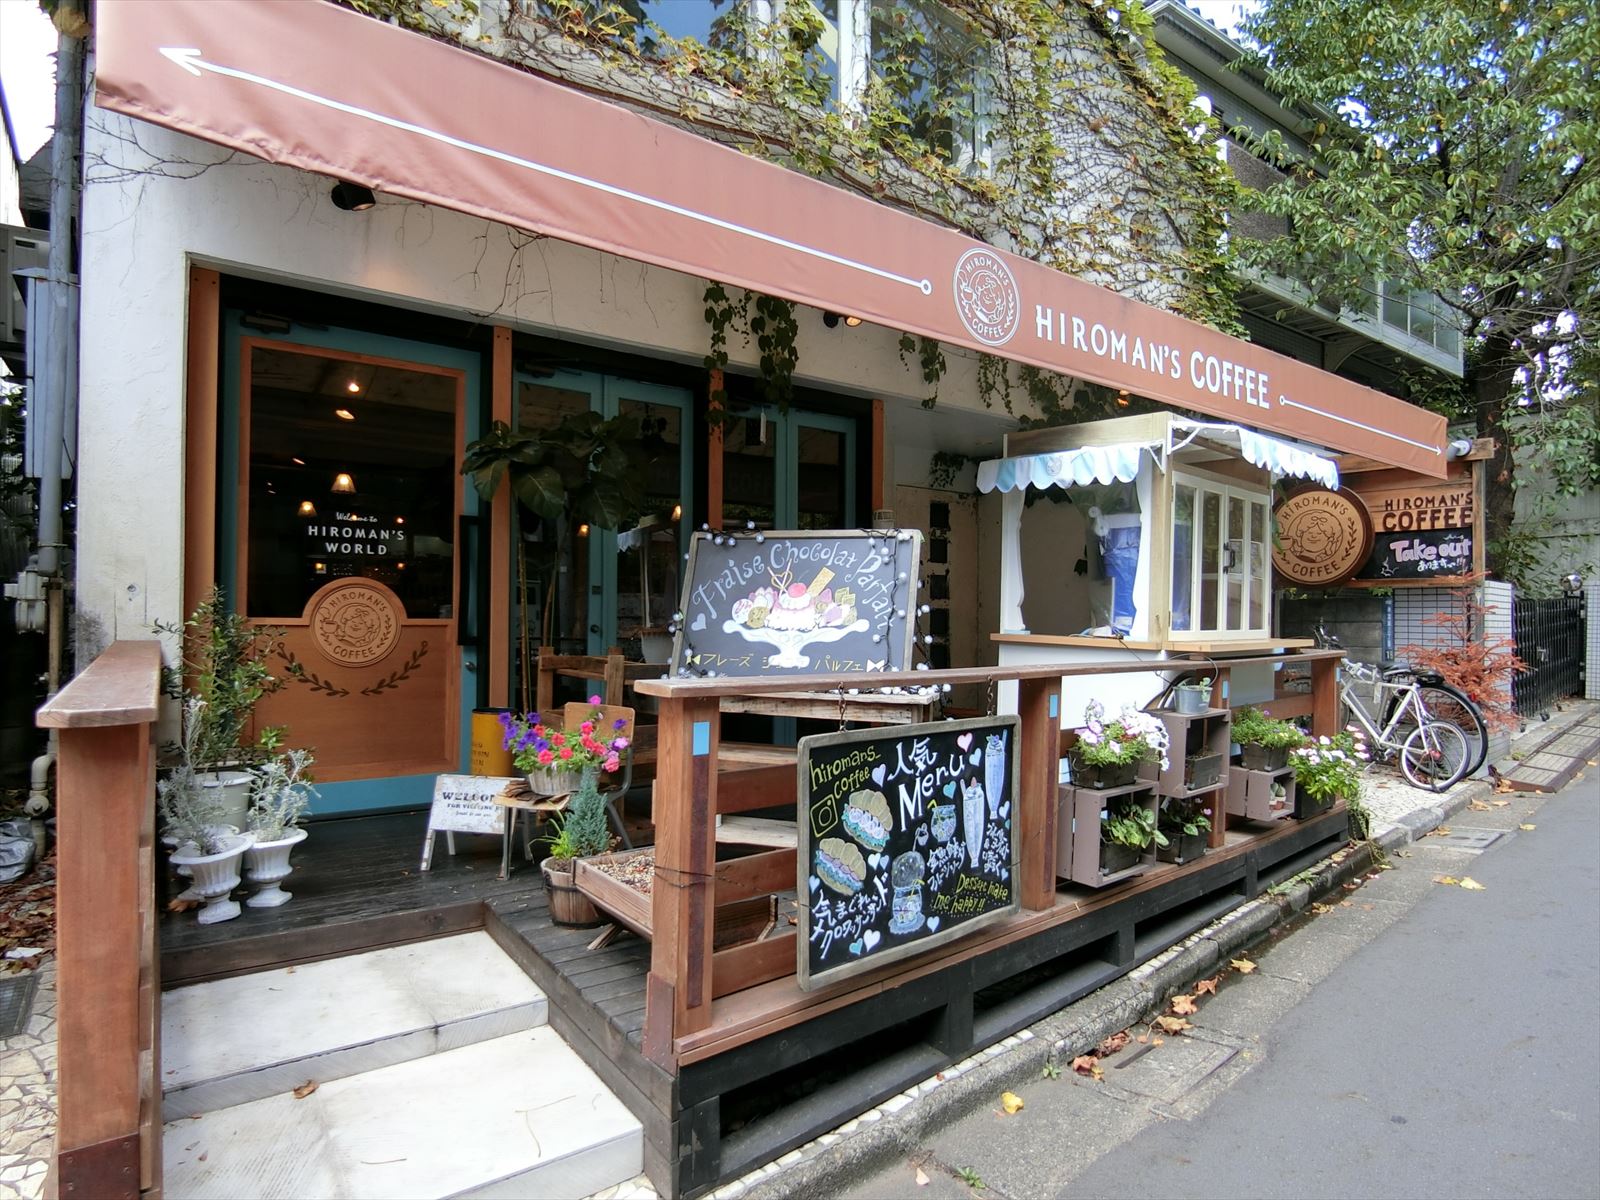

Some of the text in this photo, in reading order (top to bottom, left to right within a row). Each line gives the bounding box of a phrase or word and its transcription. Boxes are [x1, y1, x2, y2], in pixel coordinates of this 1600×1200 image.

[965, 256, 1010, 286] HIROMAN'S
[972, 318, 1004, 338] COFFEE
[1035, 304, 1271, 409] HIROMAN'S COFFEE
[1283, 495, 1349, 520] HIROMAN'S
[1385, 491, 1473, 511] HIROMAN'S
[336, 511, 378, 523] Welcme to
[1382, 507, 1473, 531] COFFEE
[308, 525, 405, 541] HIROMAN'S
[325, 541, 388, 555] WORLD
[1390, 538, 1472, 562] Take out
[1291, 559, 1341, 577] COFFEE
[692, 552, 765, 620] Fraise
[769, 539, 858, 570] Chocolat
[330, 591, 387, 612] HIROMAN'S
[333, 645, 376, 660] COFFEE
[703, 653, 754, 667] フレーズ
[814, 654, 864, 672] パルフェ
[887, 737, 938, 781] 人気
[833, 766, 871, 799] coffee
[898, 753, 965, 831] Menu
